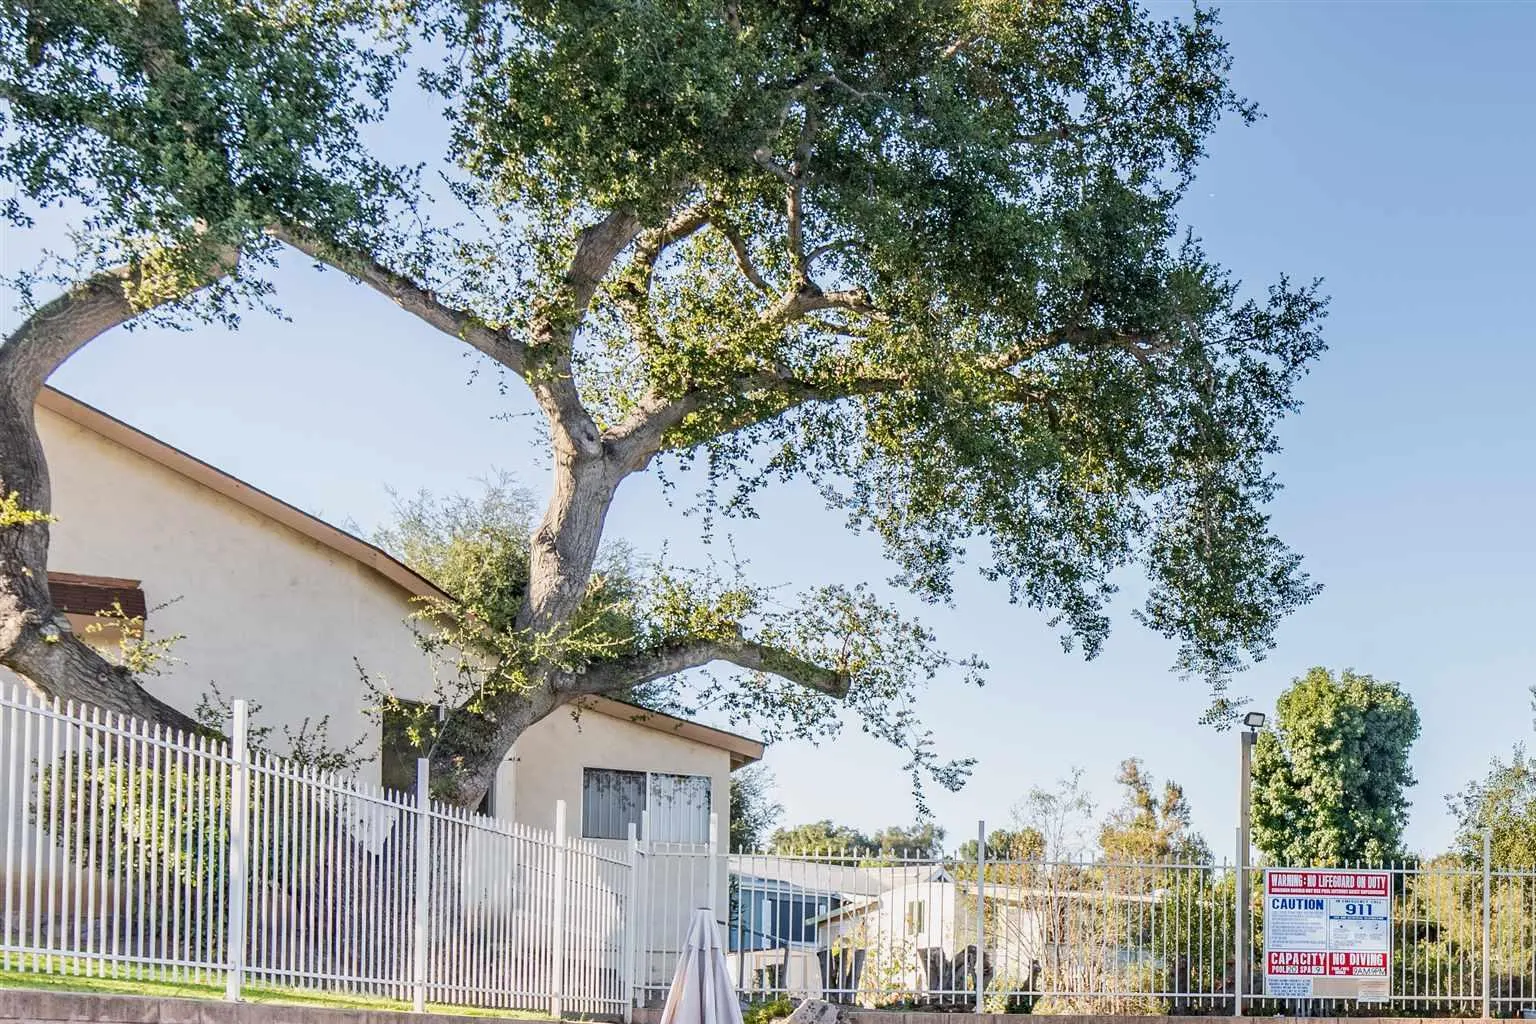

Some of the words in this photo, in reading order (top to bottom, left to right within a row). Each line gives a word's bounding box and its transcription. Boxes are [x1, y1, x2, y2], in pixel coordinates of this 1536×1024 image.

[1271, 873, 1306, 887] WARNING:
[1307, 874, 1317, 887] NO
[1318, 874, 1355, 888] LIFEGUARD
[1356, 875, 1367, 889] ON
[1367, 875, 1386, 889] DUTY
[1271, 898, 1324, 910] CAUTION
[1345, 903, 1372, 915] 911
[1271, 952, 1326, 965] CAPACITY
[1332, 952, 1346, 966] NO
[1349, 953, 1383, 966] DIVING
[1299, 965, 1311, 974] SPA
